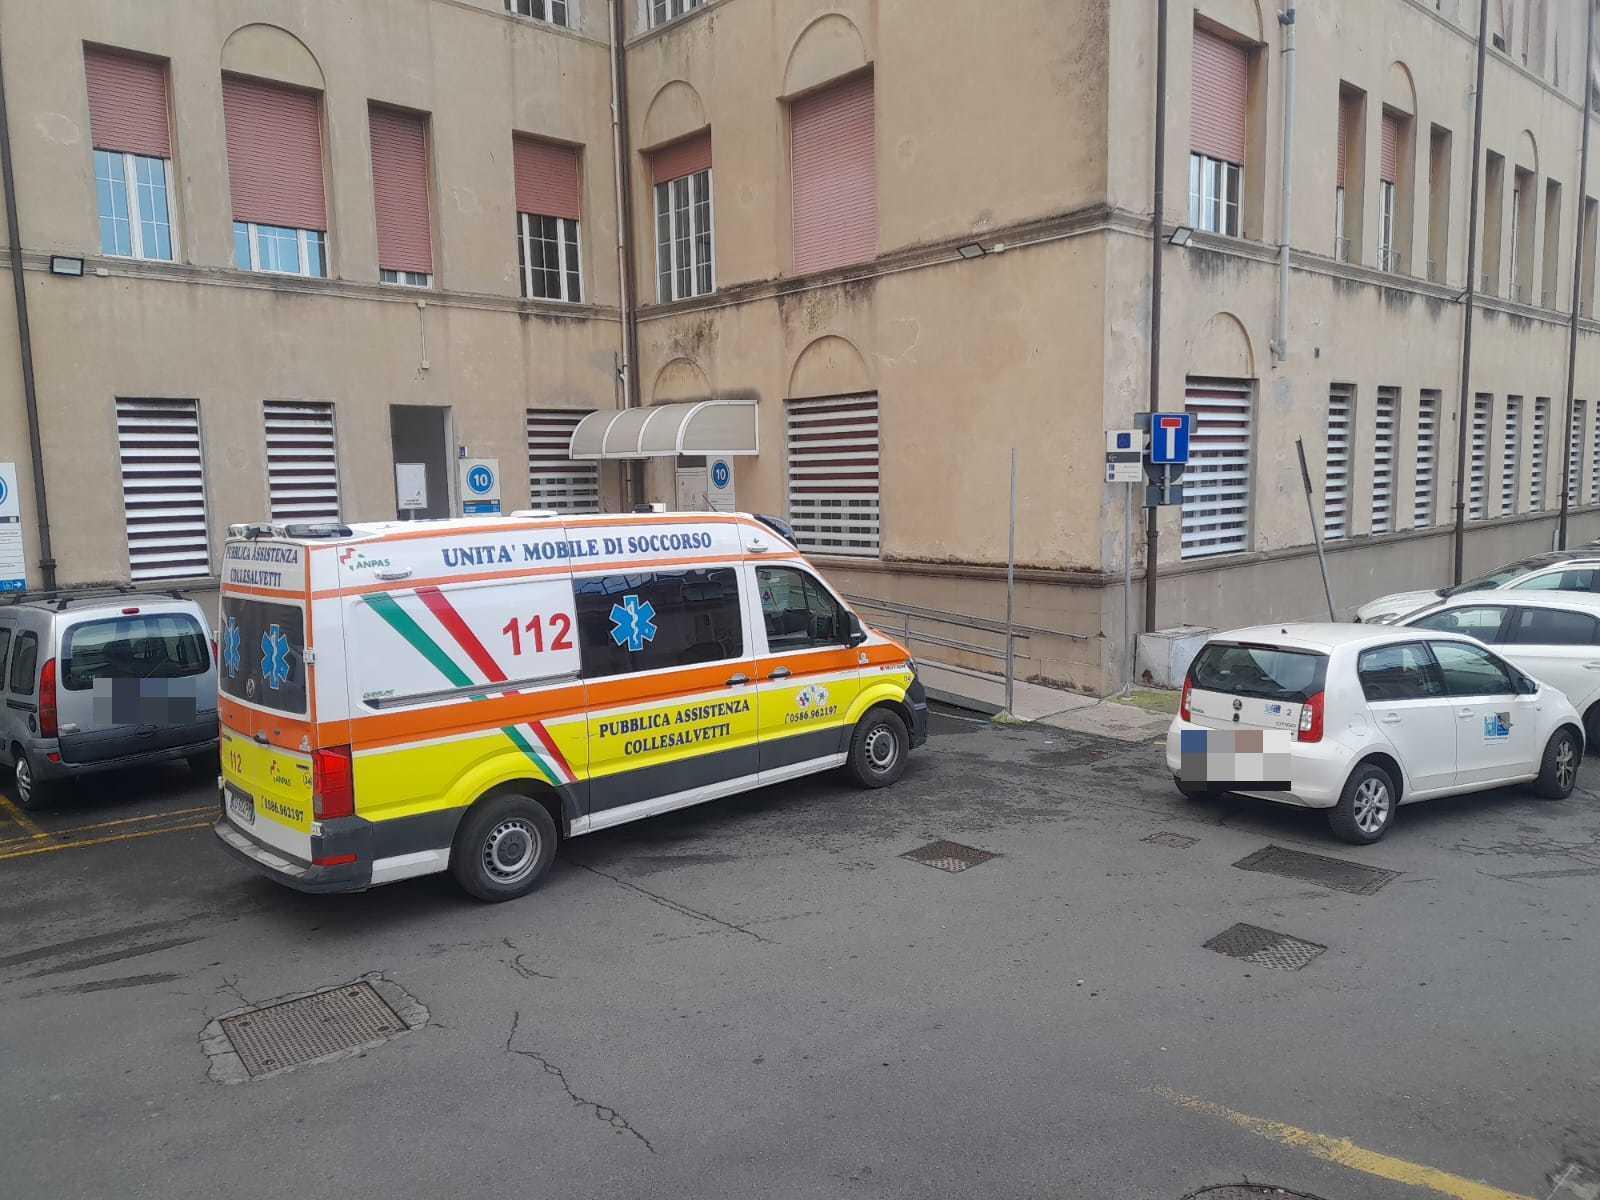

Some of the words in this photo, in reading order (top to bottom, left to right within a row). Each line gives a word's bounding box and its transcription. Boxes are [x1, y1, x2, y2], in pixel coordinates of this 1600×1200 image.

[473, 473, 489, 487] 10
[716, 468, 726, 480] 10
[252, 546, 298, 564] ASSISTENZA
[441, 544, 516, 567] UNITA'
[523, 539, 599, 561] MOBILE
[604, 537, 624, 555] DI
[628, 532, 712, 553] SOCCORSO
[356, 559, 391, 569] ANPAS
[230, 567, 282, 587] COLLESALVETTI
[502, 613, 573, 655] 112
[600, 713, 671, 738] PUBBLICA
[674, 699, 750, 724] ASSISTENZA
[624, 723, 731, 755] COLLESALVETTI
[230, 749, 242, 774] 112
